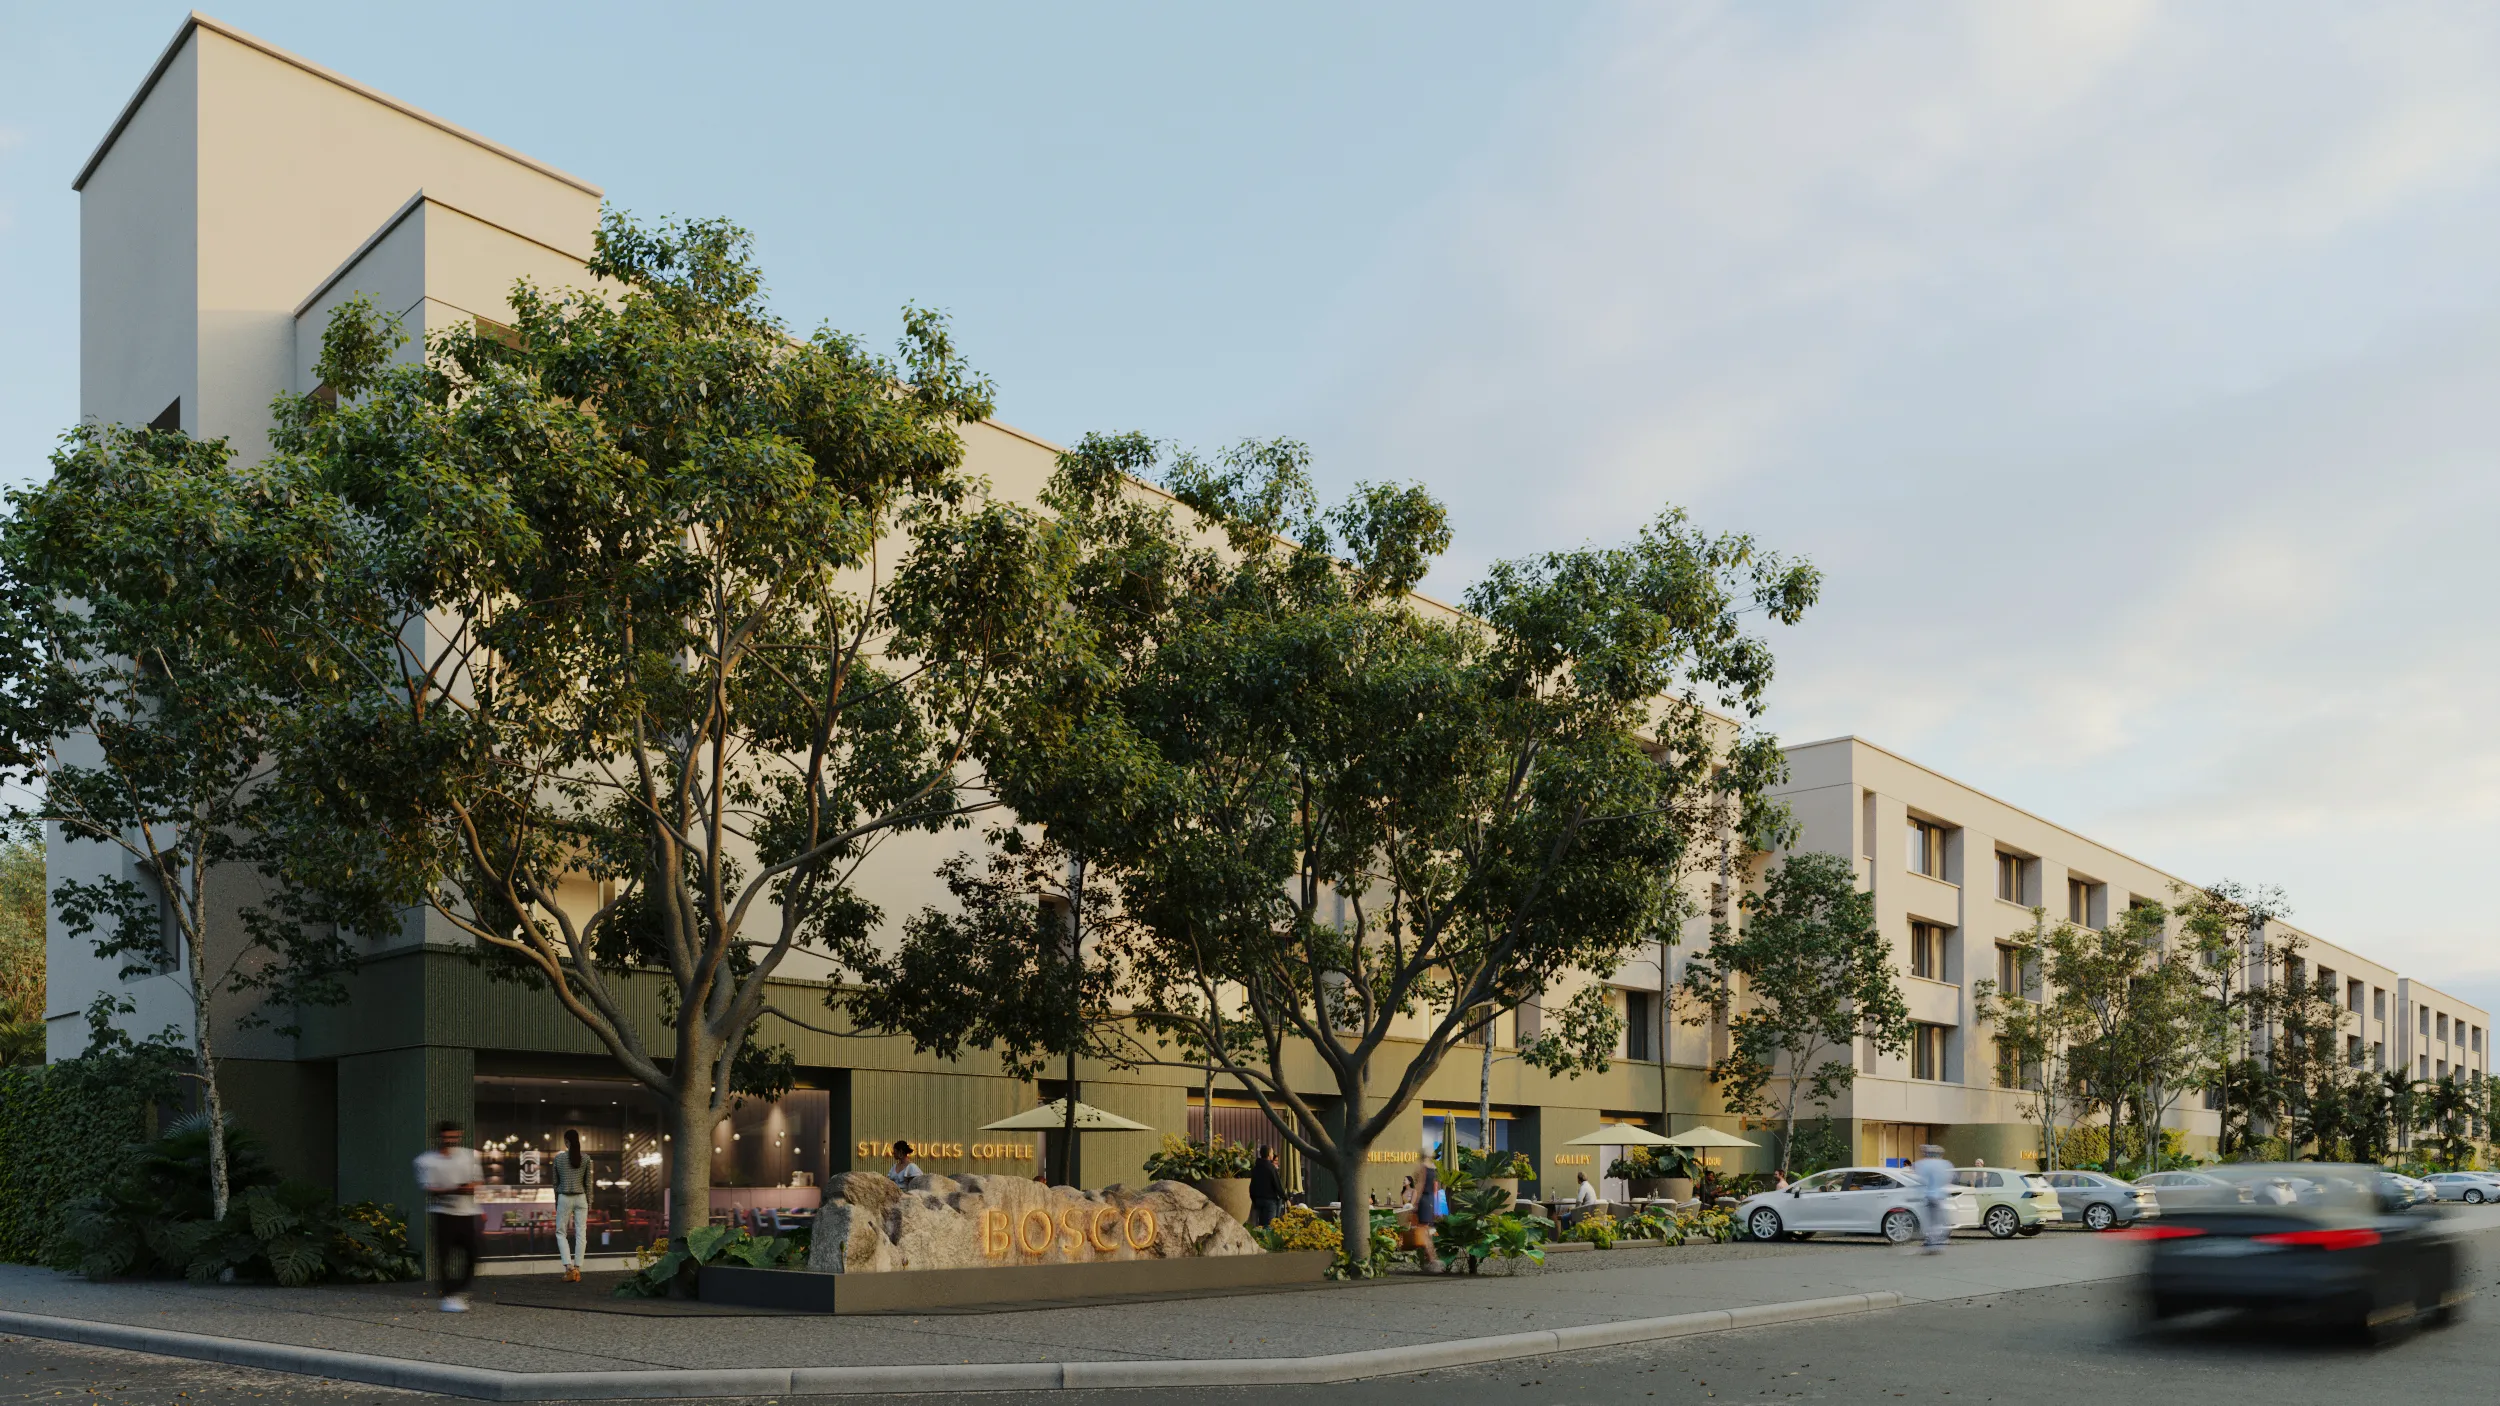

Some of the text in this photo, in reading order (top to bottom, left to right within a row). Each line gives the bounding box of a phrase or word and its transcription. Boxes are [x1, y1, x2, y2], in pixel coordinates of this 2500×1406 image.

[857, 1141, 1034, 1159] STABUCKS COFFEE
[1555, 1154, 1592, 1165] GALLERY
[984, 1207, 1156, 1254] BOSCO
